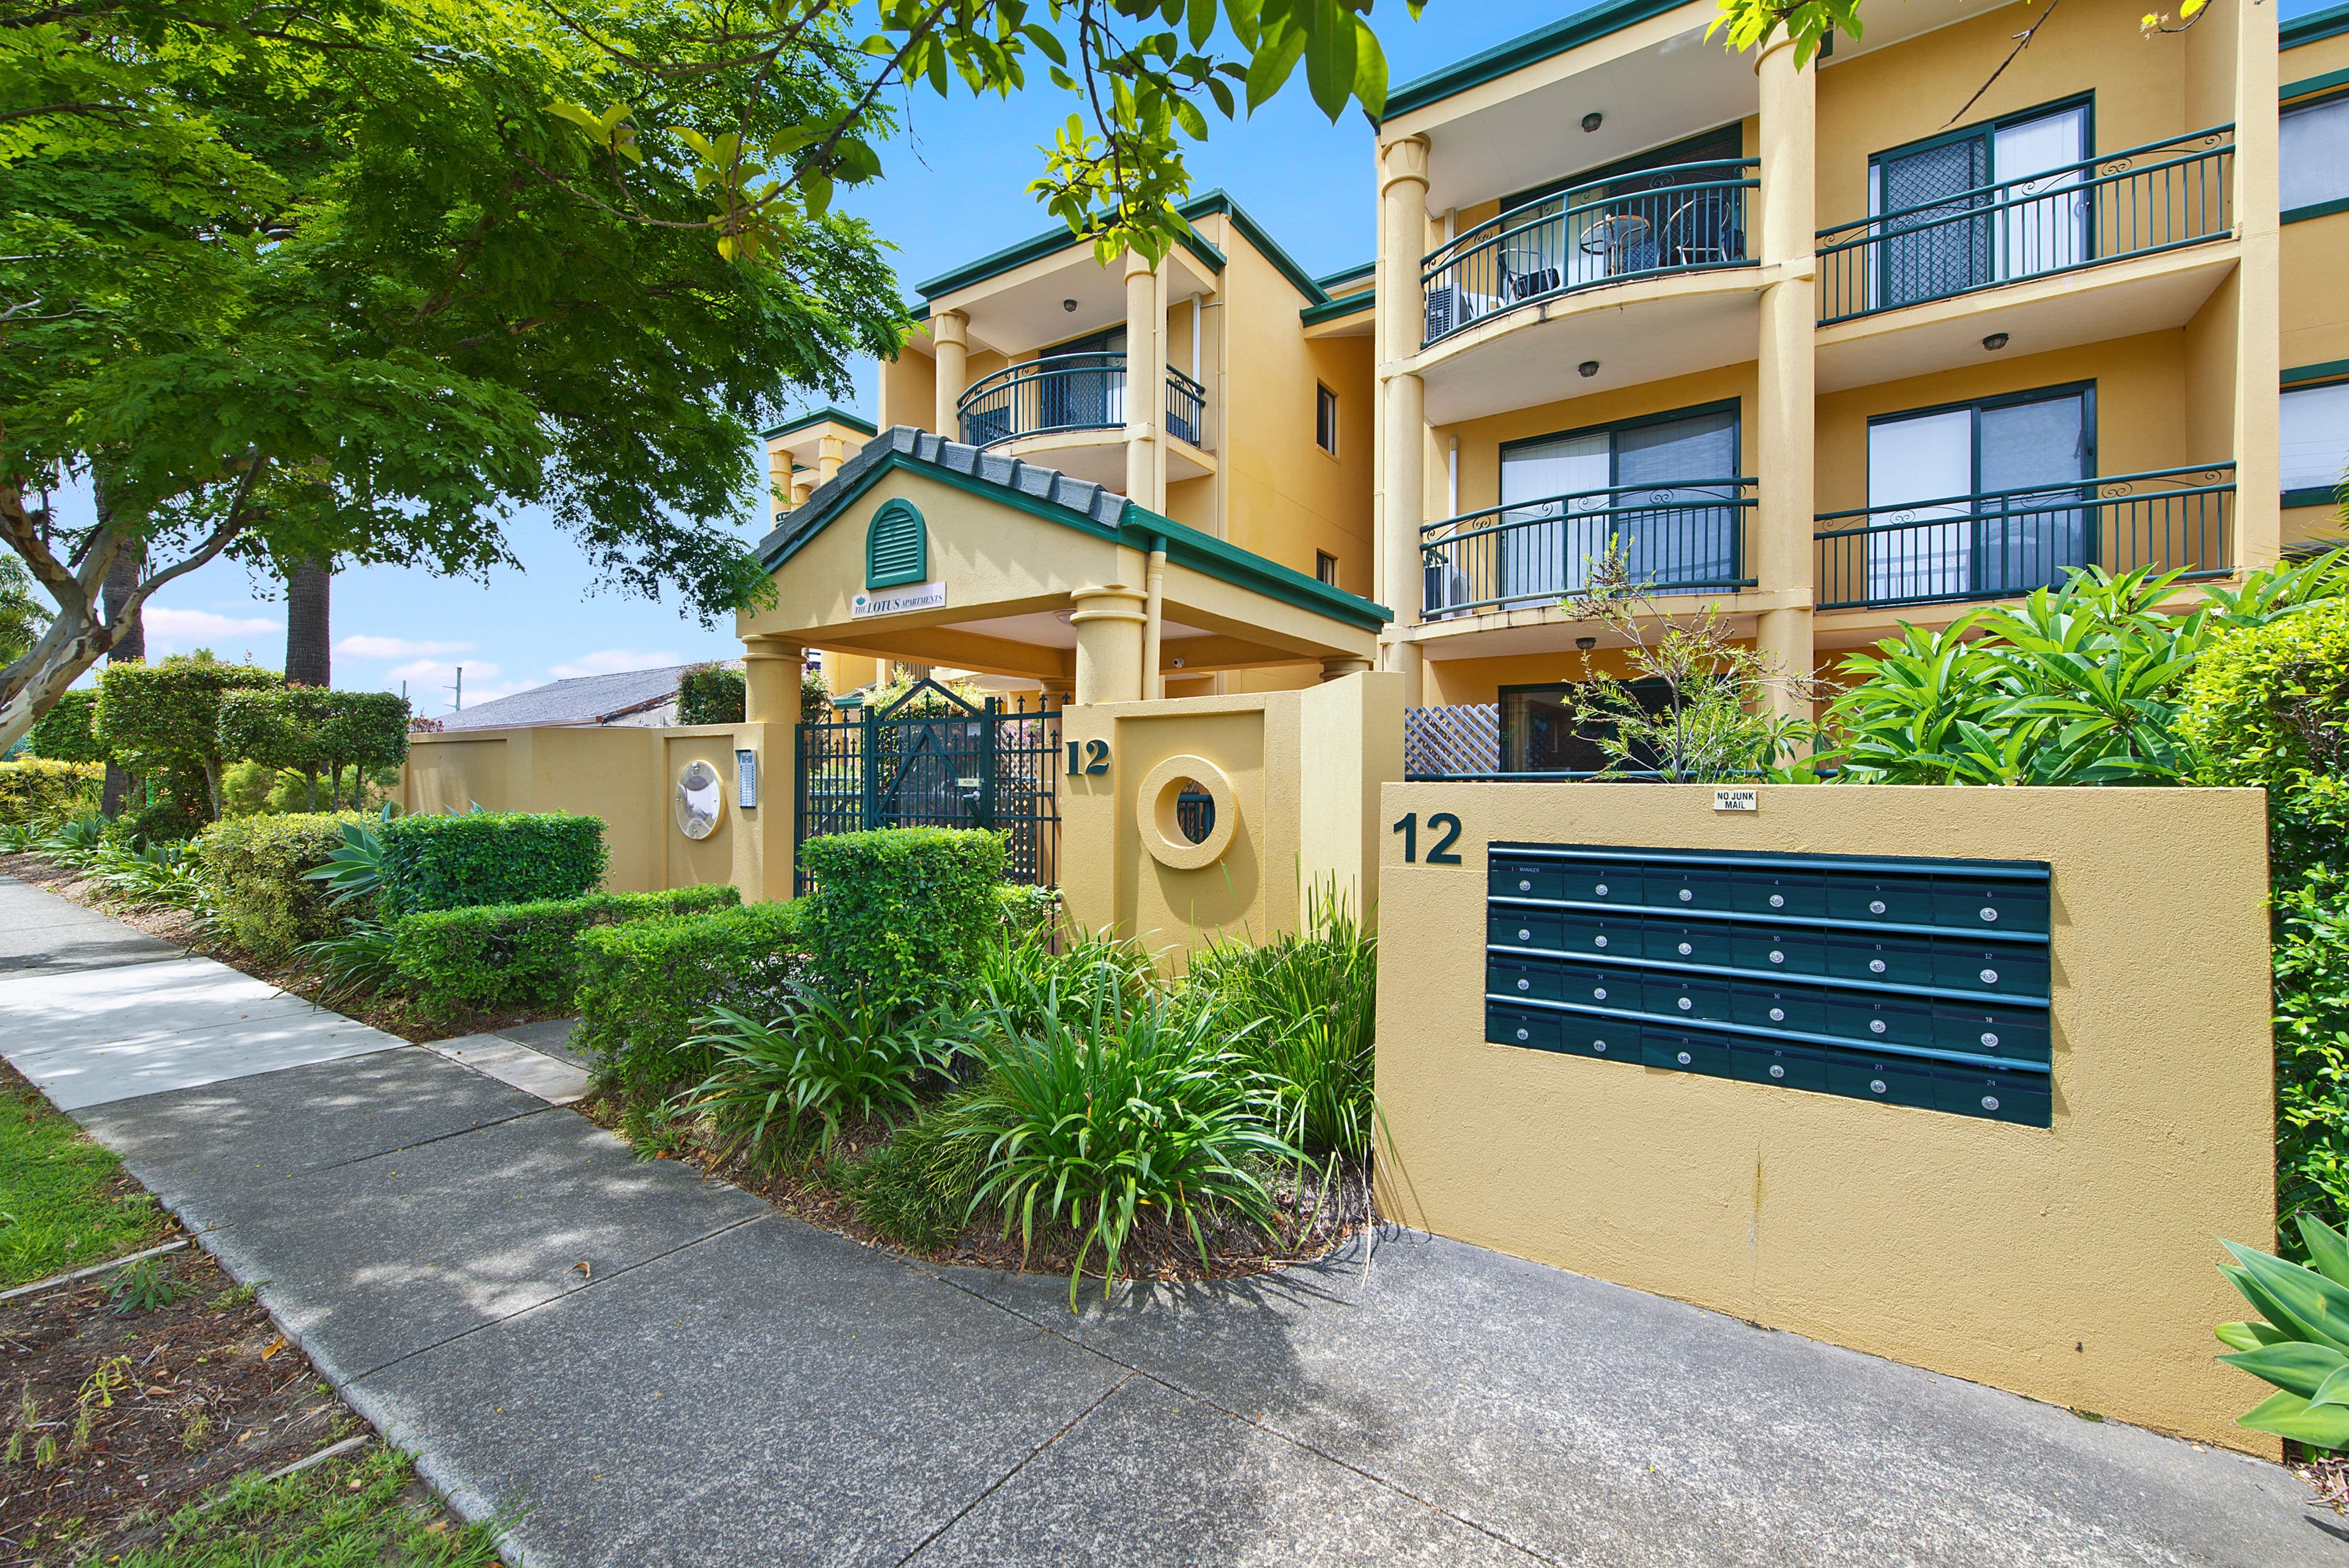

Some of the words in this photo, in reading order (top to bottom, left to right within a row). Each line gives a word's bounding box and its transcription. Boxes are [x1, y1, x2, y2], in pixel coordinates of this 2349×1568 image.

[867, 598, 900, 613] LOTUS
[902, 594, 943, 608] APARTMENTS
[1065, 738, 1110, 775] 12
[1725, 801, 1746, 809] MAIL
[1393, 812, 1462, 864] 12
